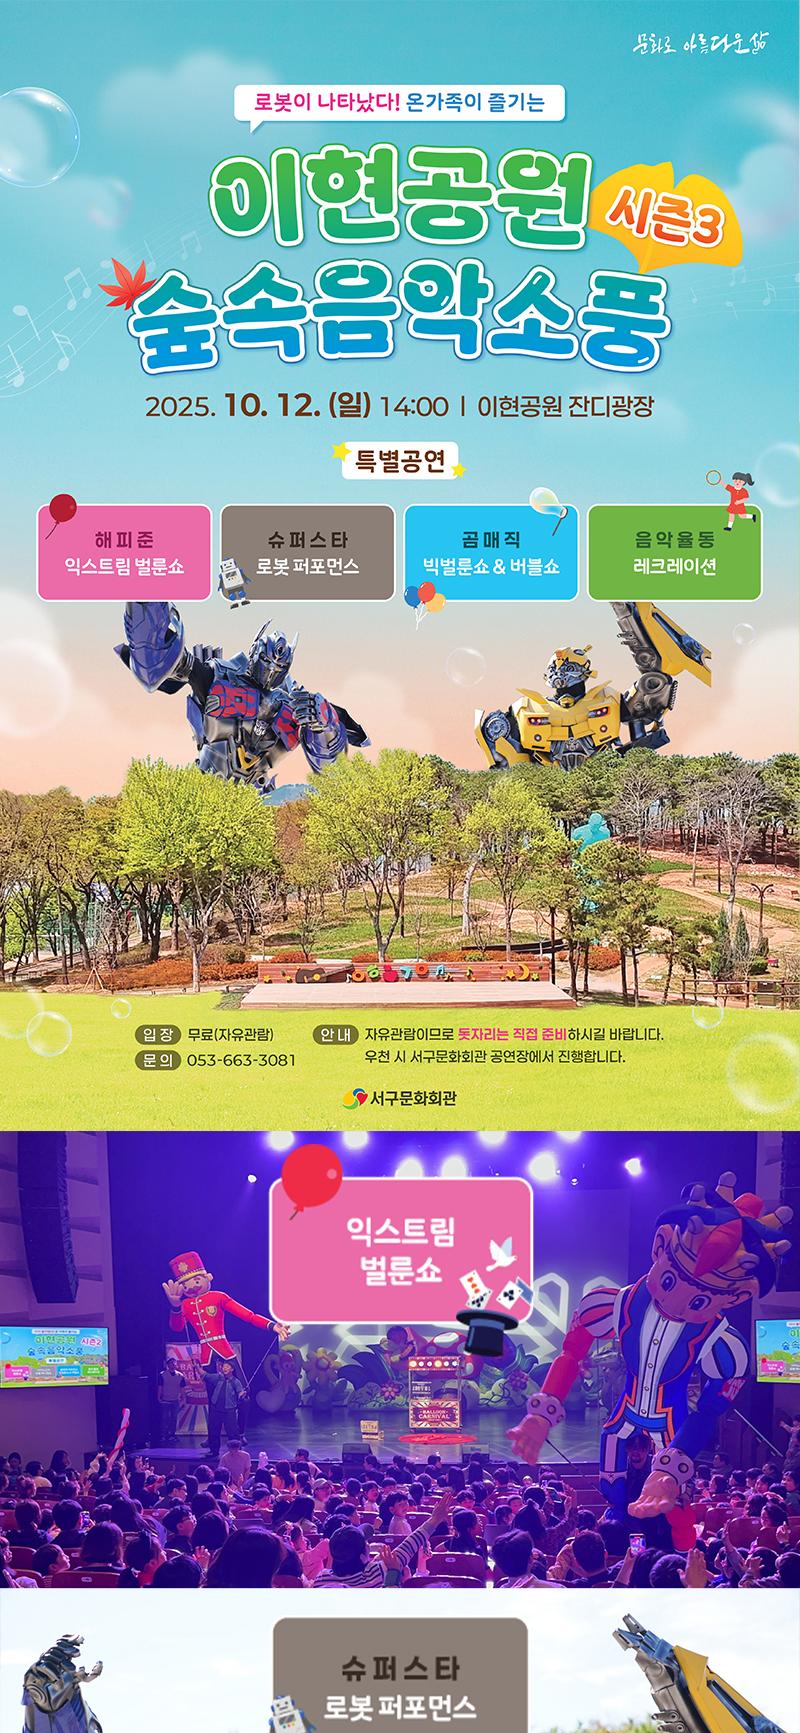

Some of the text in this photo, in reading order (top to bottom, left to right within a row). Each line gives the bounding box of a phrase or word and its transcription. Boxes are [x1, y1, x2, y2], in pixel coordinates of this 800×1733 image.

[631, 30, 771, 56] 문화로 아름다운 삶
[254, 91, 546, 113] 로봇이 나타났다! 온가족이 즐기는
[209, 143, 725, 250] 이현공원 시즌3
[128, 258, 672, 374] 숲속음악소풍
[145, 396, 216, 417] 2025.
[224, 392, 268, 418] 10.
[277, 392, 321, 417] 12.
[328, 391, 371, 419] (일)
[380, 396, 450, 417] 14:00
[477, 395, 563, 418] 이현공원
[568, 393, 656, 418] 잔디광장
[354, 449, 446, 474] 특별공연
[64, 557, 185, 577] 익스트림 벌룬쇼
[255, 557, 360, 577] 로봇 퍼포먼스
[423, 557, 560, 577] 빅벌룬쇼 & 버블쇼
[633, 557, 717, 577] 레크레이션
[187, 1027, 274, 1042] 무료(자유관람)
[364, 1027, 664, 1042] 자유관람이므로 돗자리는 직접 준비하시길 바랍니다.
[186, 1053, 295, 1067] 053-663-3081
[364, 1049, 626, 1064] 우천 시 서구문화회관 공연장에서 진행합니다.
[369, 1088, 458, 1108] 서구문화회관
[346, 1216, 455, 1248] 익스트림
[360, 1255, 443, 1286] 벌룬쇼
[323, 1694, 478, 1722] 로봇 퍼포먼스
